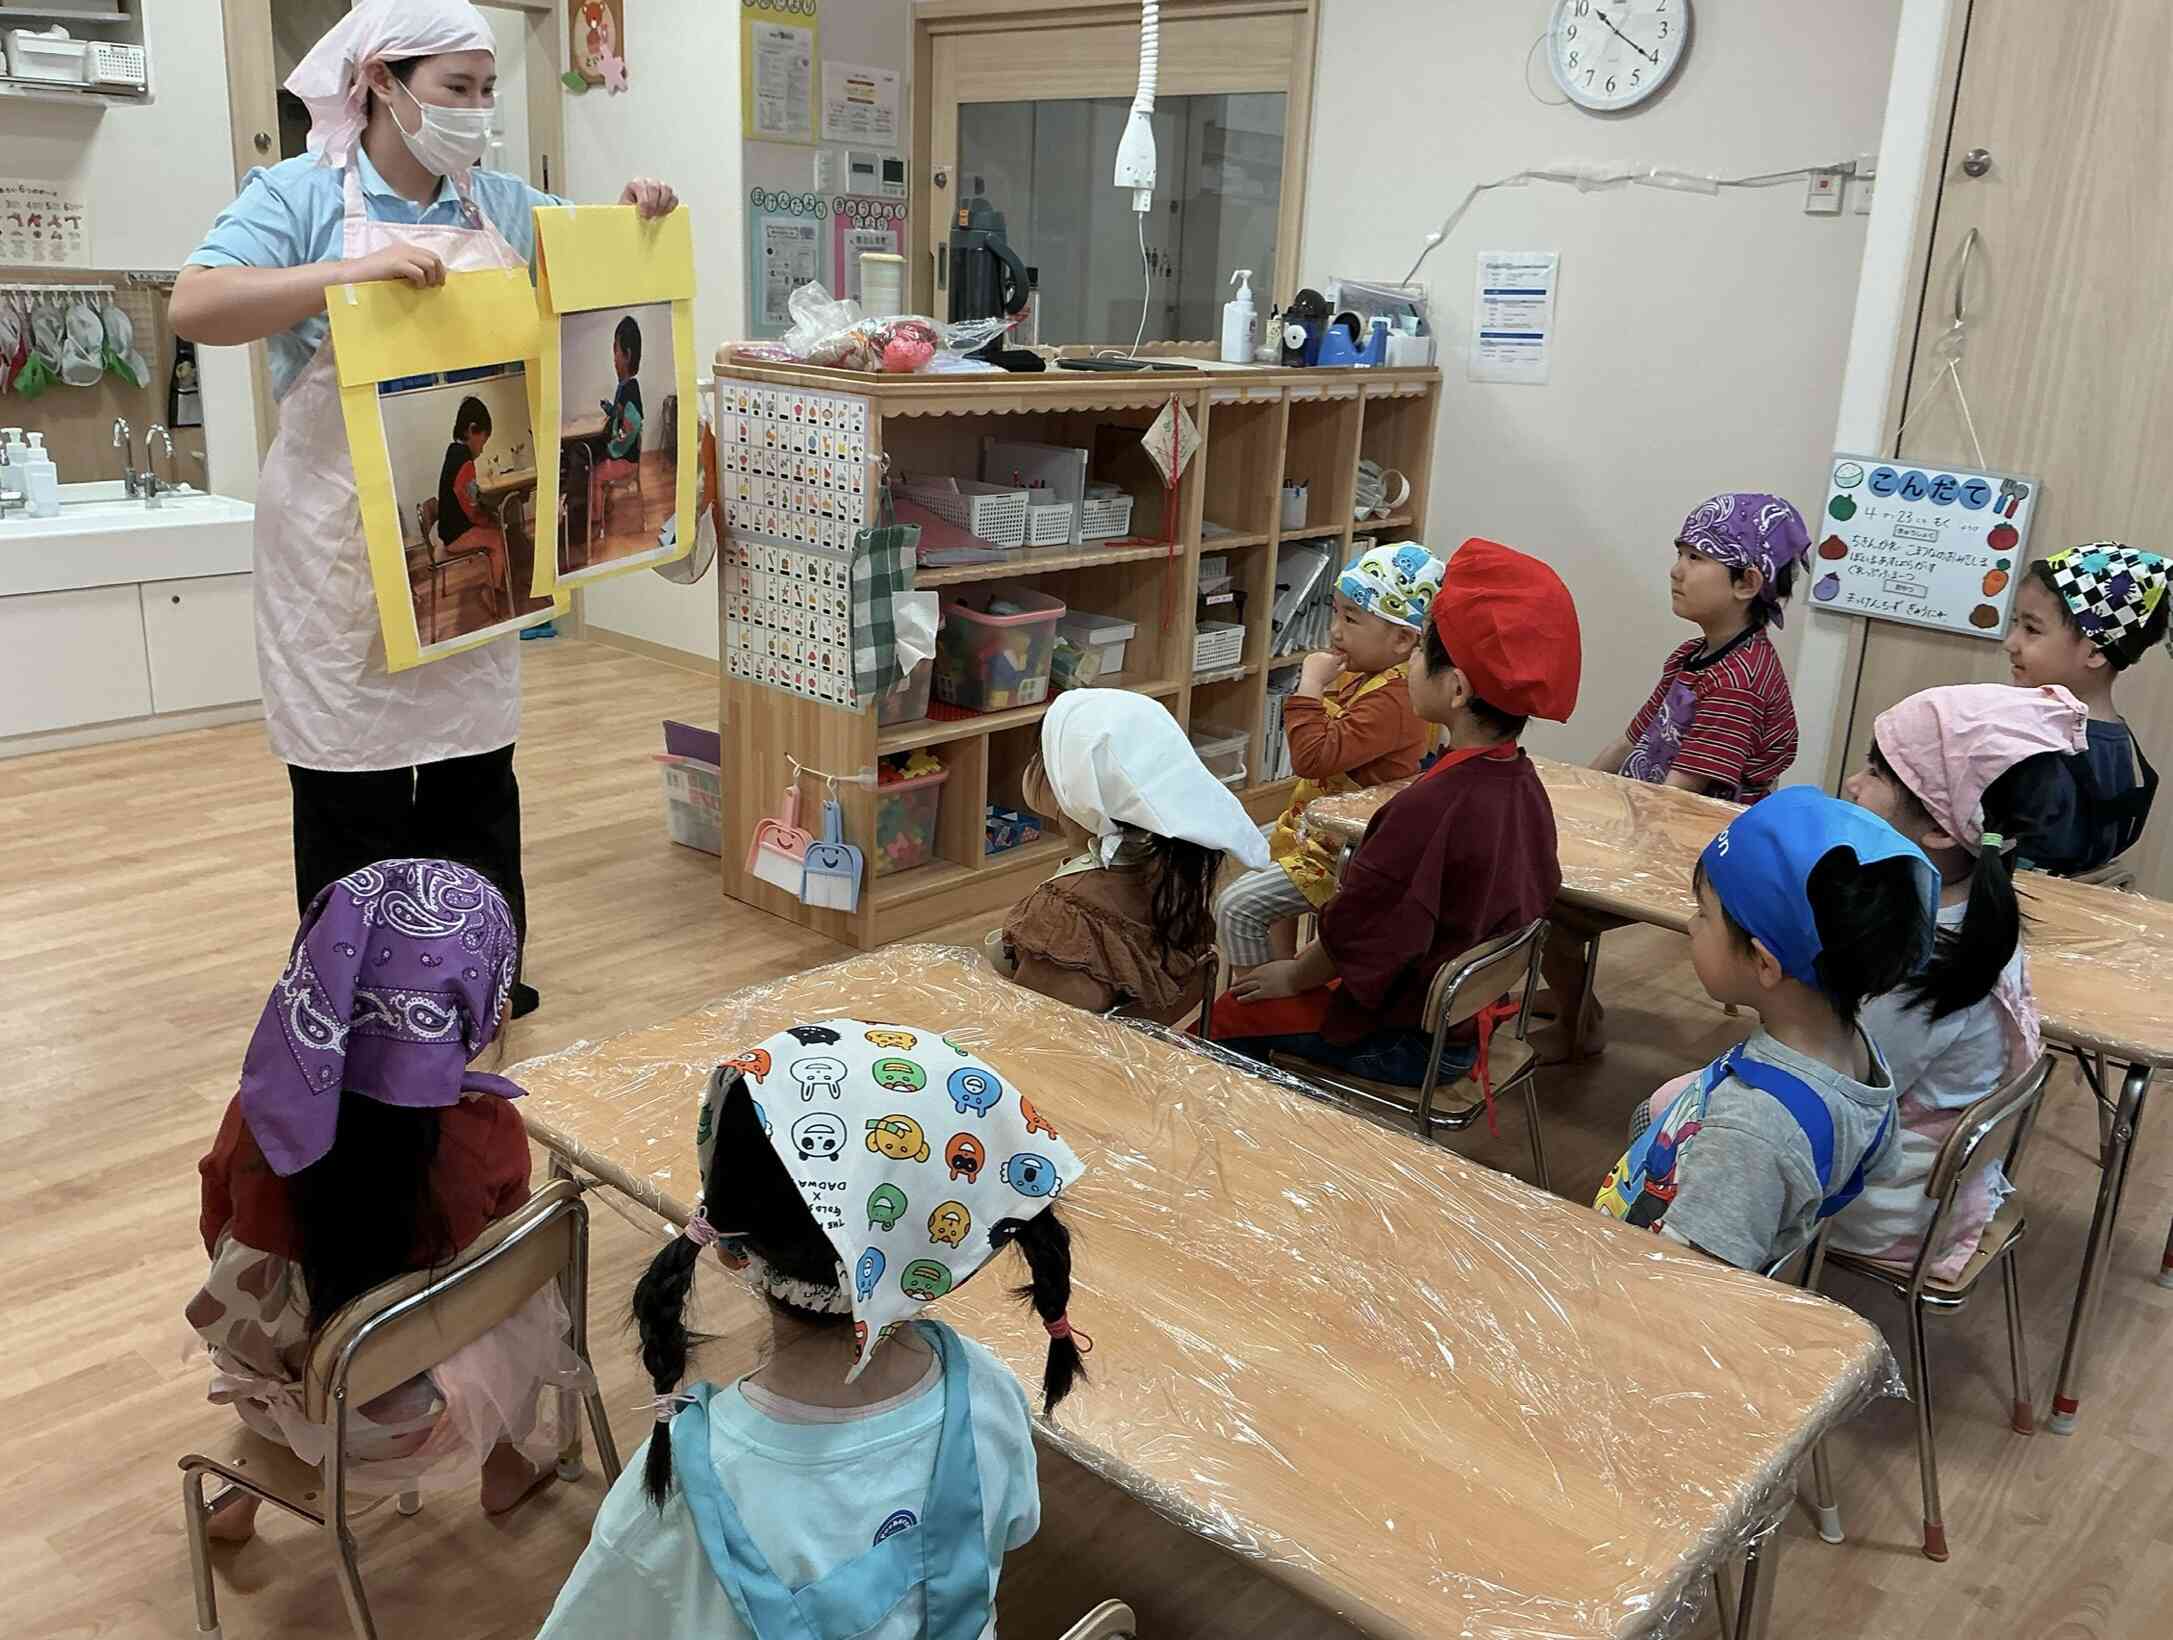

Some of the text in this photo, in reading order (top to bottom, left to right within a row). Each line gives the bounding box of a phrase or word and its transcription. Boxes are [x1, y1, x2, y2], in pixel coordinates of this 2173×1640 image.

[1573, 0, 1589, 17] 10
[1655, 0, 1667, 12] 2
[1567, 24, 1577, 42] 9
[1657, 21, 1668, 39] 3
[1568, 51, 1579, 69] 8
[1649, 49, 1659, 65] 4
[1585, 69, 1596, 87] 7
[1605, 75, 1616, 93] 6
[1629, 68, 1641, 87] 5
[1873, 473, 1987, 505] こんだて
[1897, 510, 1913, 524] 23
